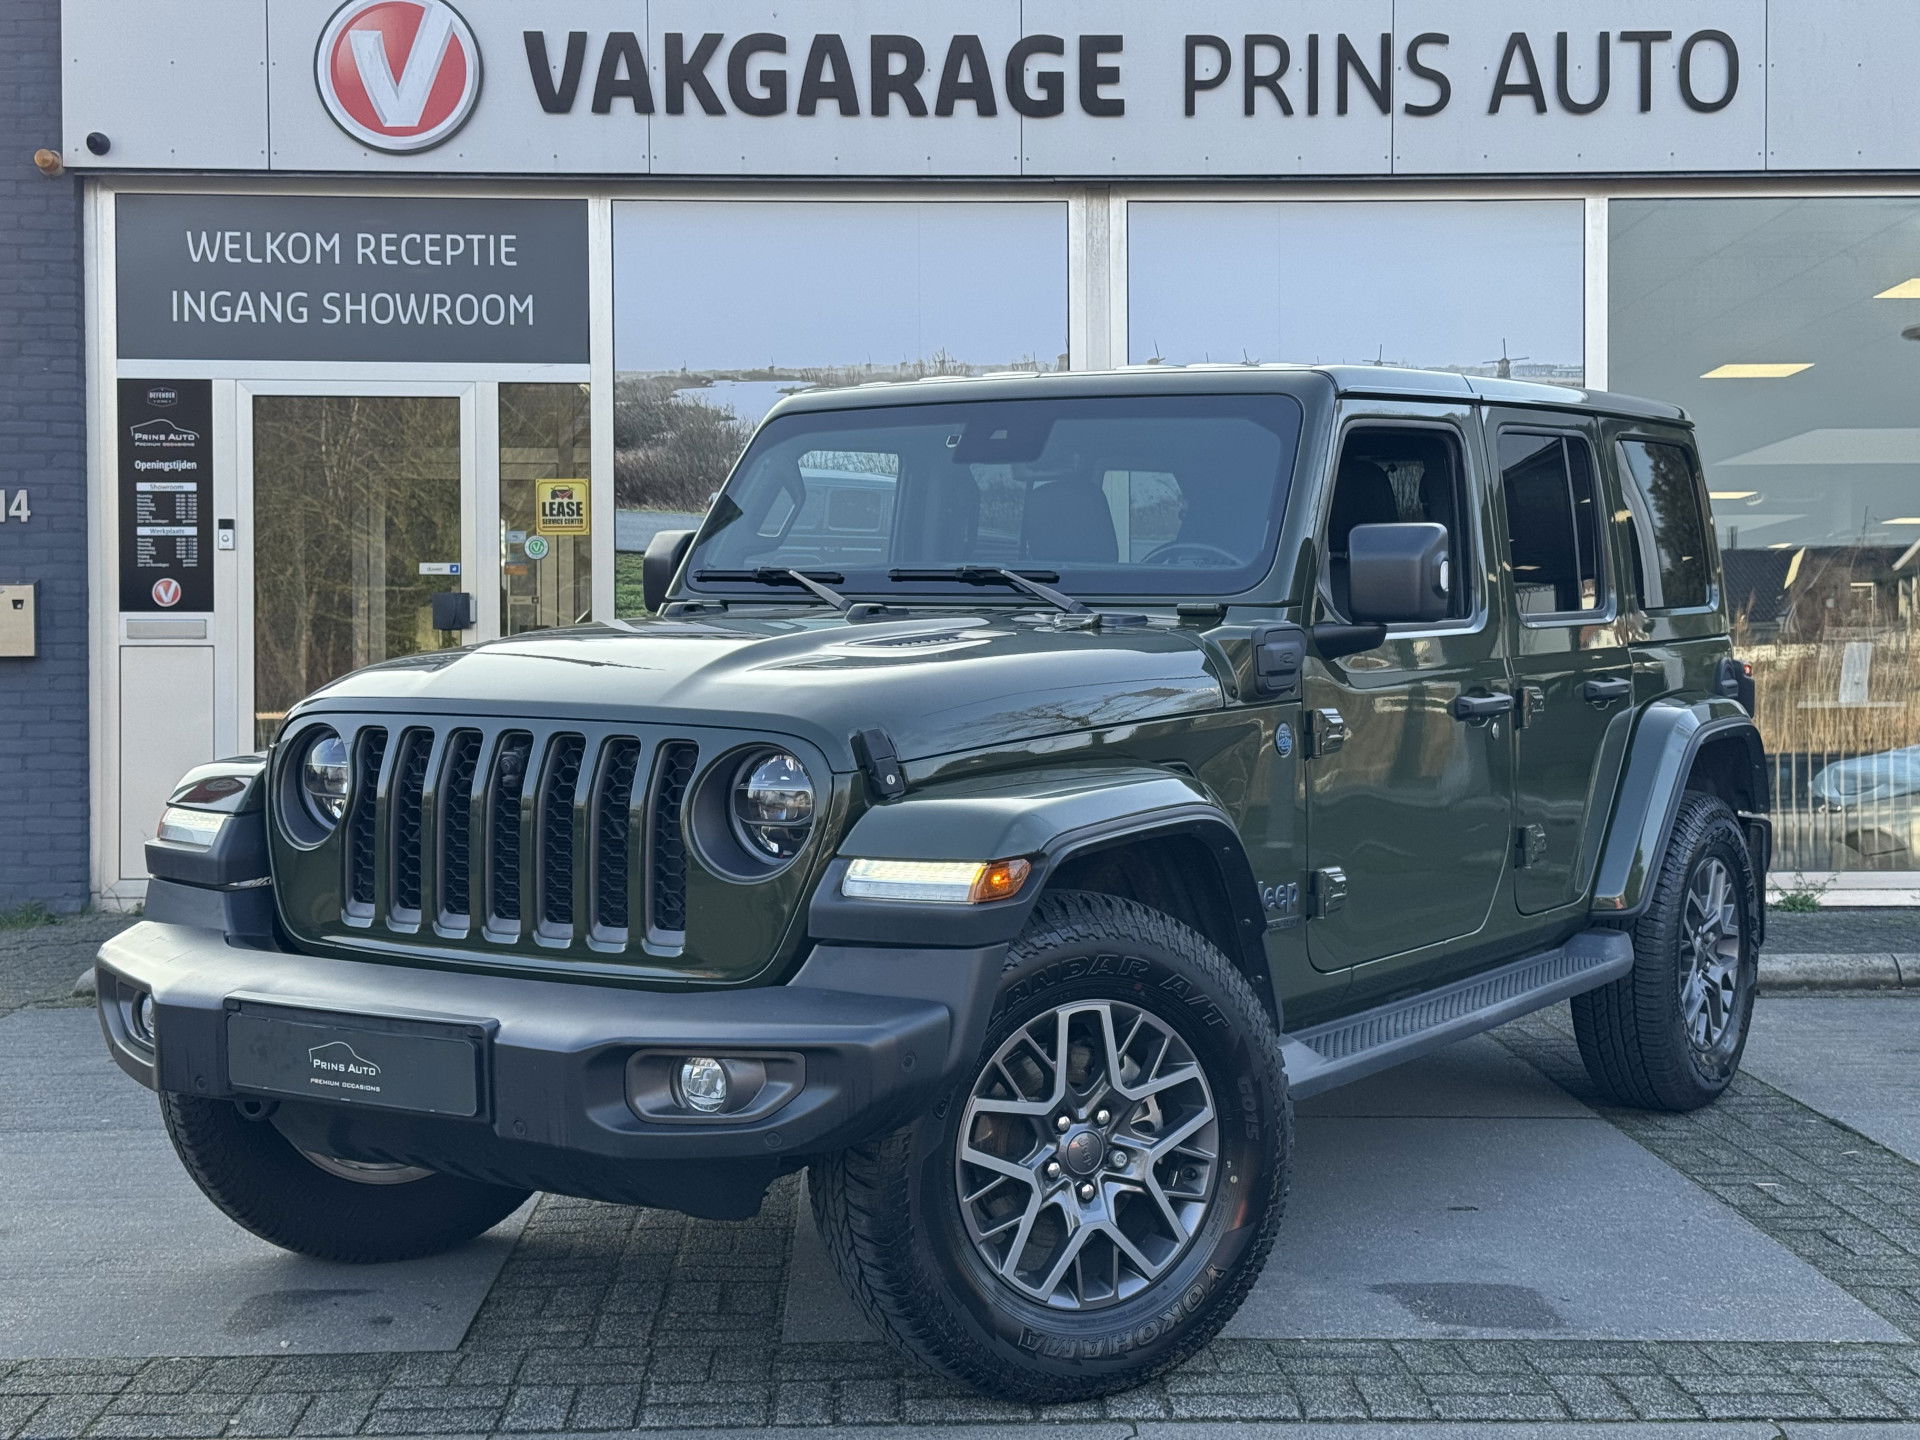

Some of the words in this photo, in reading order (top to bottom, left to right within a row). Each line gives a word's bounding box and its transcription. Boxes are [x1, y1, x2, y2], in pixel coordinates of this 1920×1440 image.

[523, 31, 1125, 118] VAKGARAGE
[1184, 32, 1452, 117] PRINS
[1488, 29, 1739, 115] AUTO
[186, 231, 341, 265] WELKOM
[356, 233, 517, 266] RECEPTIE
[171, 291, 308, 324] INGANG
[322, 292, 534, 326] SHOWROOM
[134, 433, 166, 441] PRINS
[168, 433, 195, 441] AUTO
[134, 460, 197, 472] Openingstijden
[541, 501, 583, 517] LEASE
[313, 1059, 345, 1072] PRINS
[347, 1063, 376, 1076] AUTO
[310, 1077, 340, 1087] PREMIUM
[342, 1081, 381, 1092] OCCASIONS
[1017, 1263, 1227, 1361] YOKOHAMA
